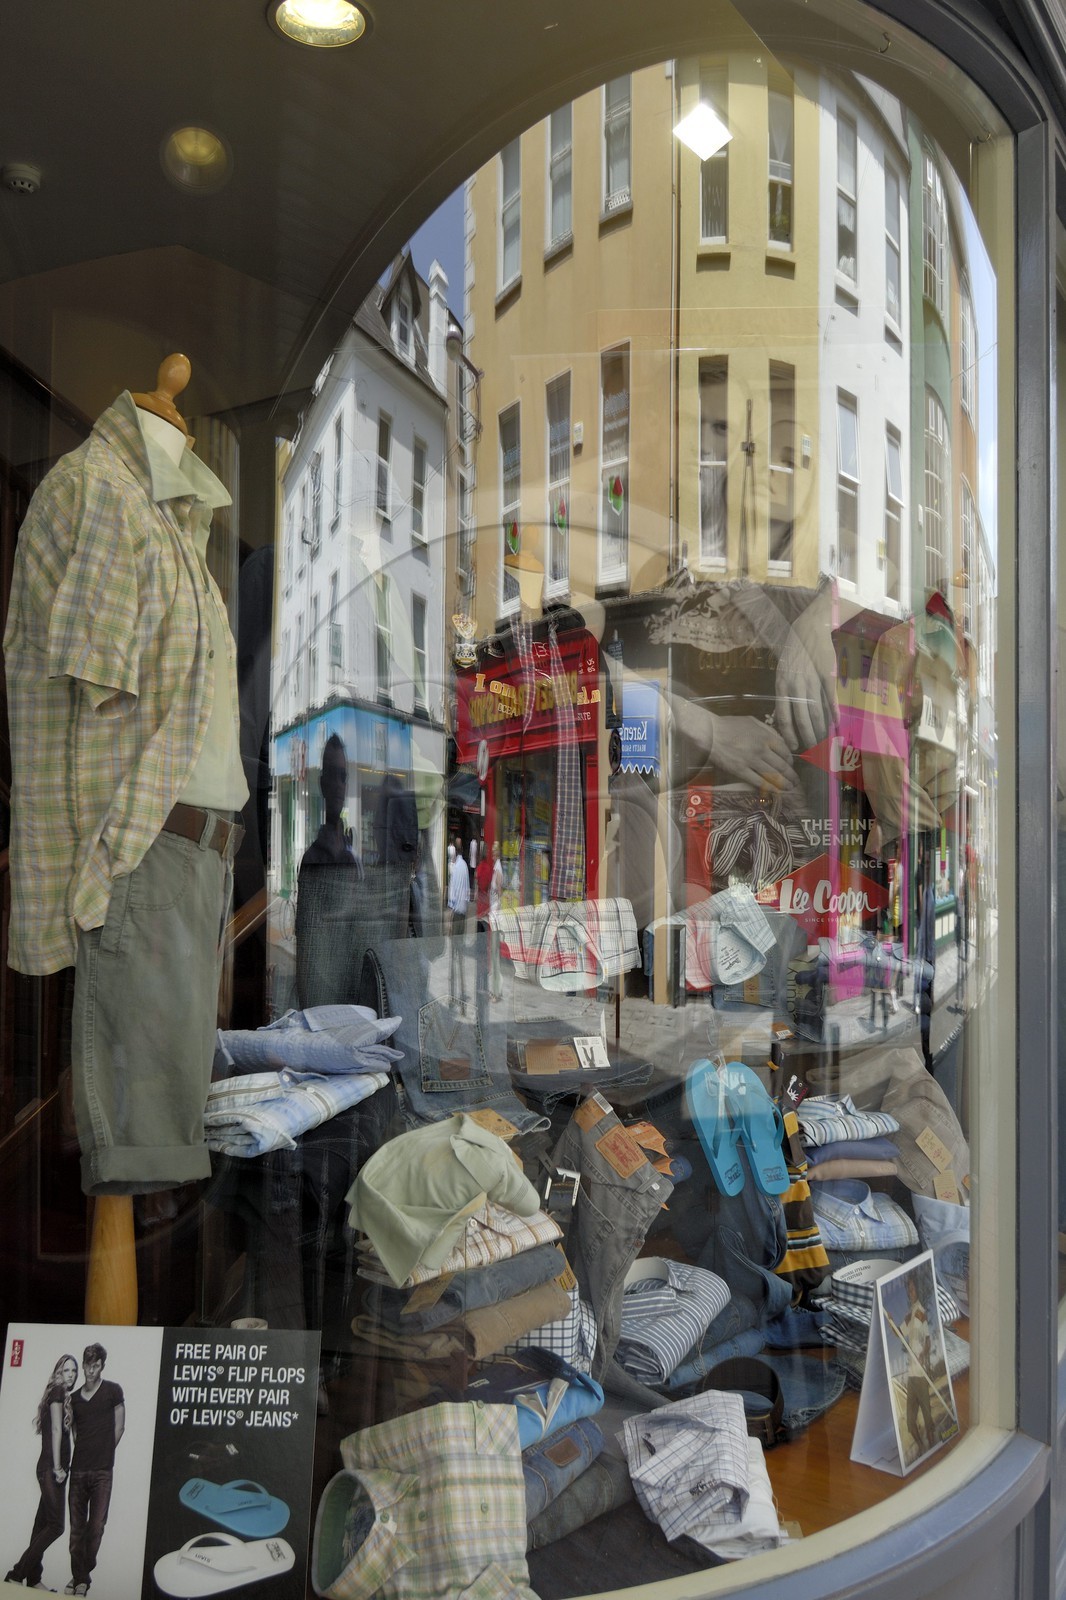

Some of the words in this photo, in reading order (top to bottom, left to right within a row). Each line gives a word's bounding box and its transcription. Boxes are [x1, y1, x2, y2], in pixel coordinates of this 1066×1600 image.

[829, 736, 862, 772] Lee
[801, 819, 833, 831] THE
[810, 834, 864, 846] DENIM
[848, 860, 884, 869] SINCE
[780, 878, 811, 915] Lee
[813, 879, 879, 917] Cooper
[175, 1343, 211, 1360] FREE
[215, 1344, 247, 1361] PAIR
[249, 1345, 268, 1361] OF
[228, 1366, 258, 1382] FLIP
[261, 1367, 306, 1384] FLOPS
[172, 1386, 207, 1403] WITH
[210, 1388, 255, 1404] EVERY
[258, 1389, 290, 1405] PAIR
[170, 1408, 190, 1425] OF
